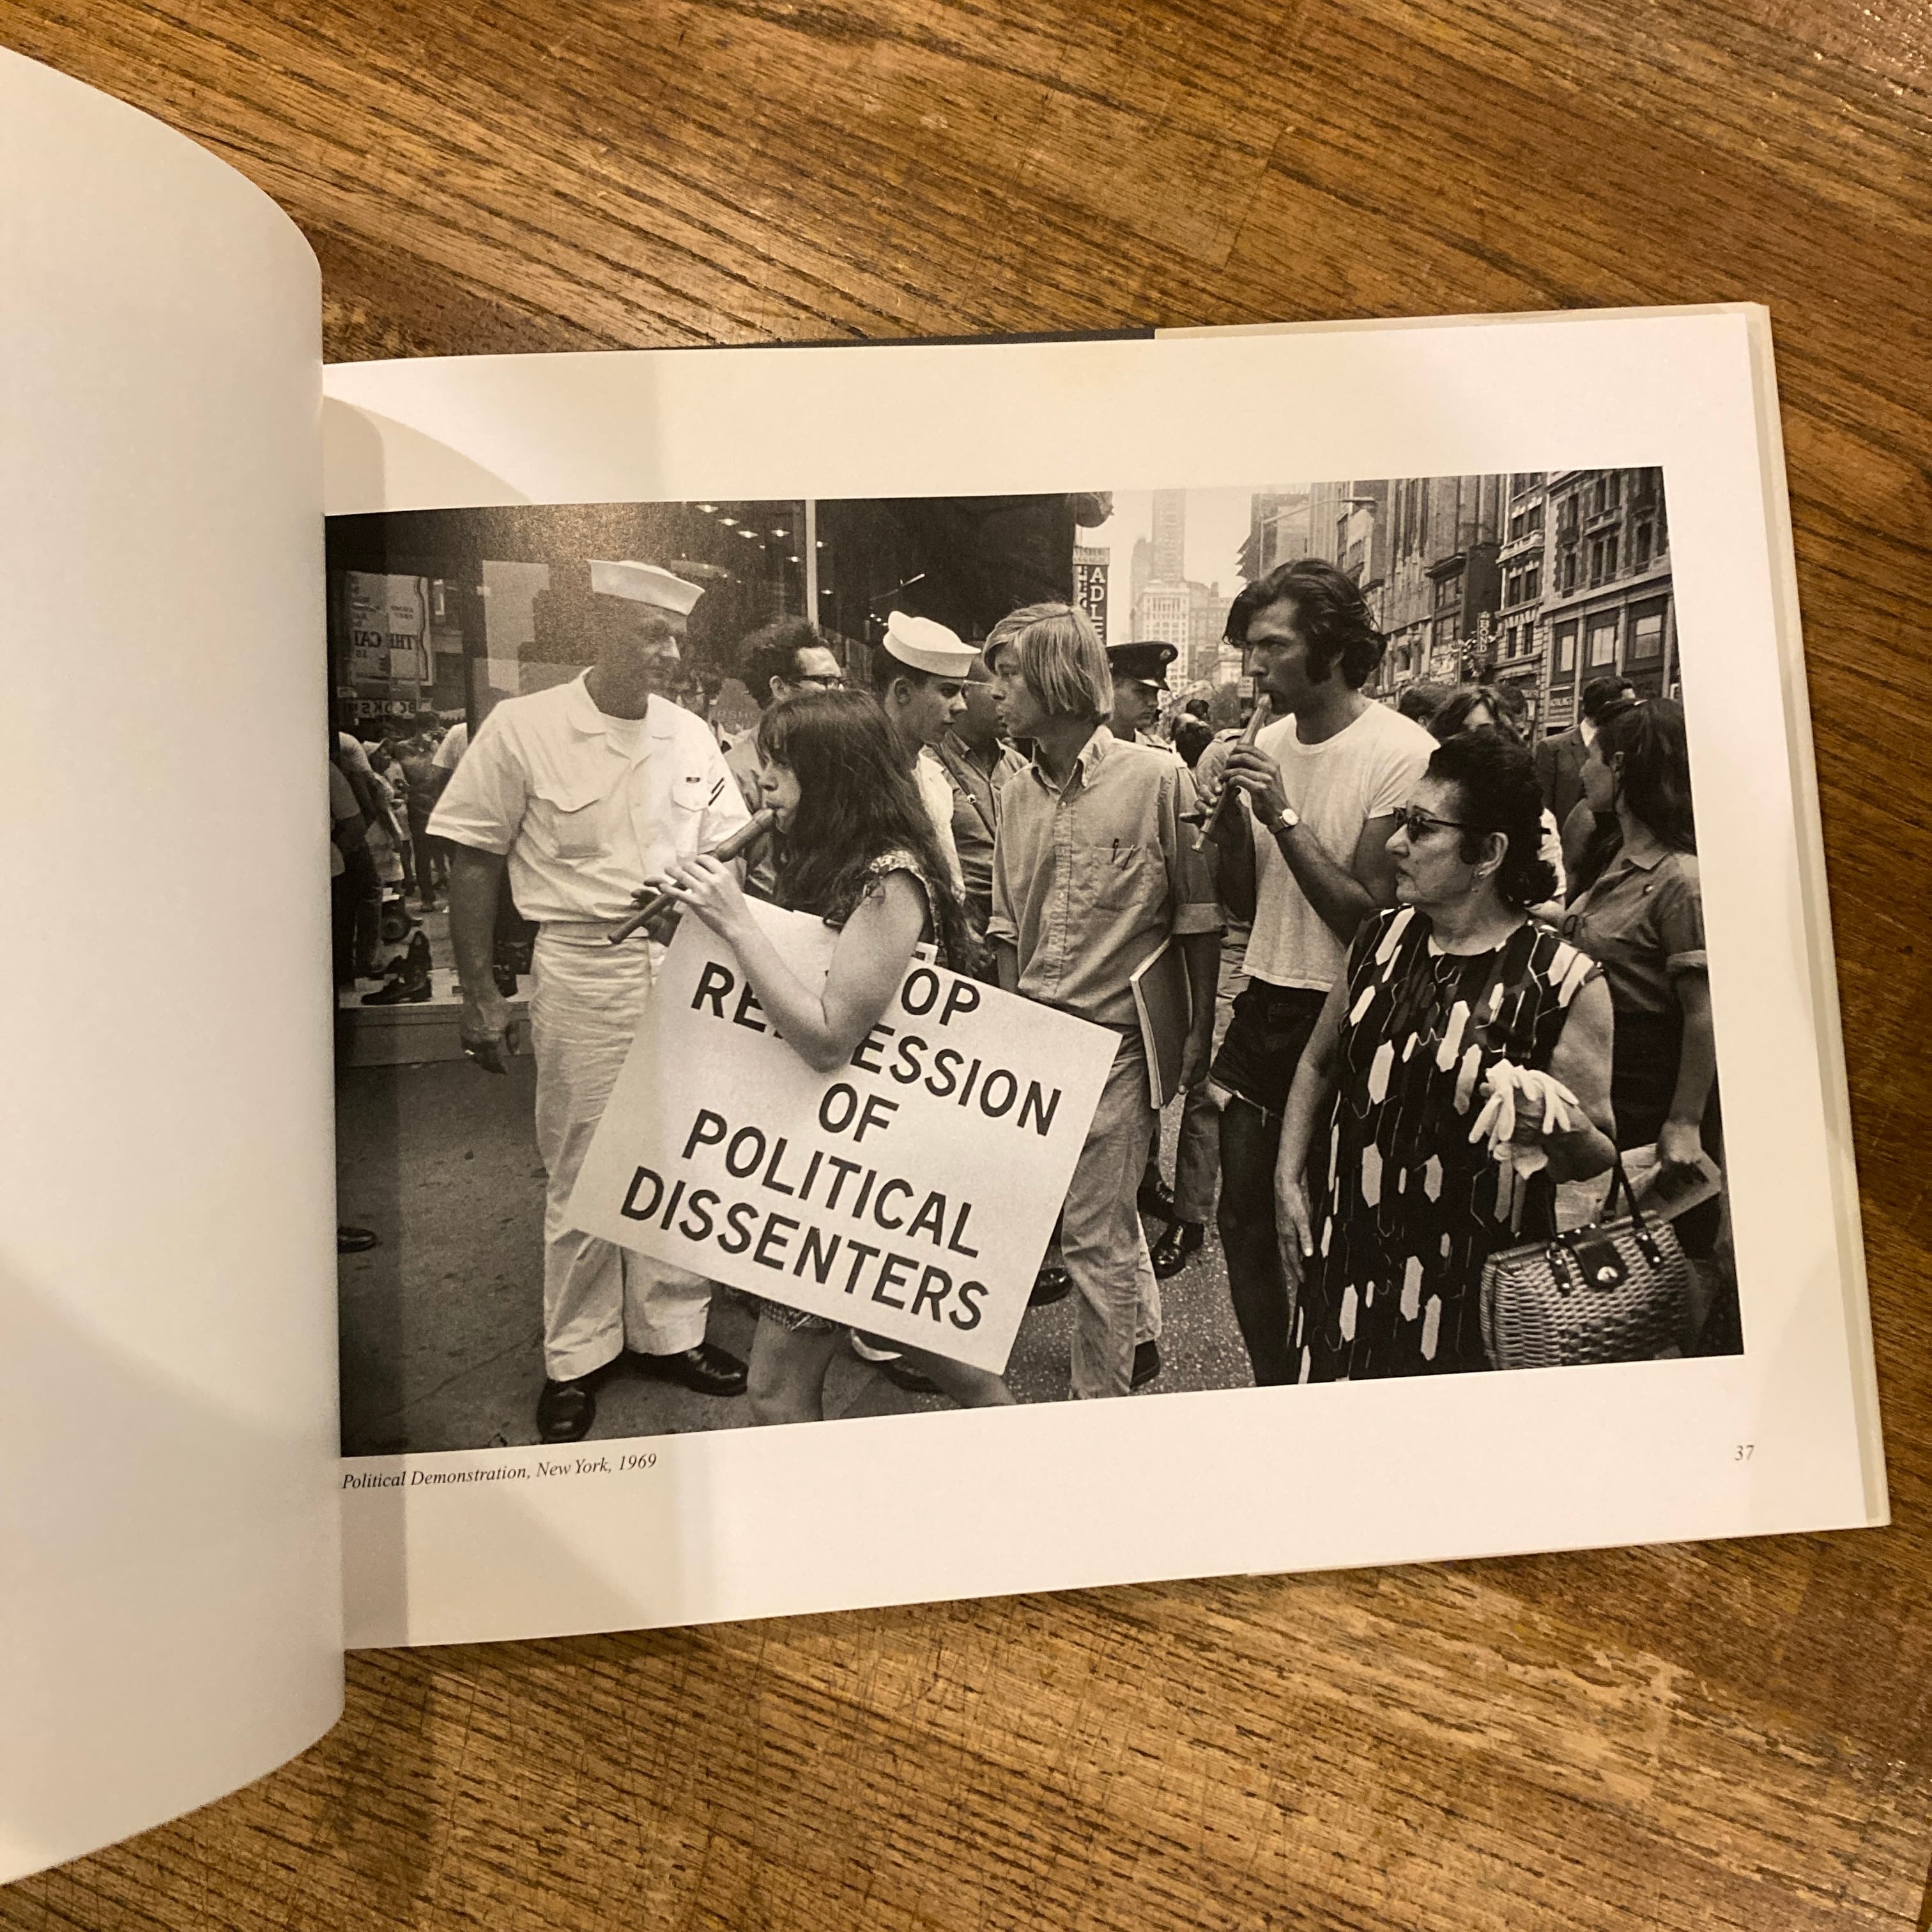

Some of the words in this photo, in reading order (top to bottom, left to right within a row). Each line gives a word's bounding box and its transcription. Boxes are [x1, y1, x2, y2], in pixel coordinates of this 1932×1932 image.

[1480, 619, 1490, 652] BOND
[901, 968, 980, 1026] OP
[691, 961, 1062, 1137] REESSION
[818, 1083, 900, 1142] OF
[682, 1108, 979, 1258] POLITICAL
[620, 1165, 988, 1331] DISSENTERS
[341, 1470, 407, 1490] Political
[410, 1465, 531, 1487] Demonstration,
[535, 1461, 572, 1478] New
[574, 1456, 612, 1475] York,
[618, 1453, 657, 1471] 1969
[1735, 1445, 1754, 1461] 37
